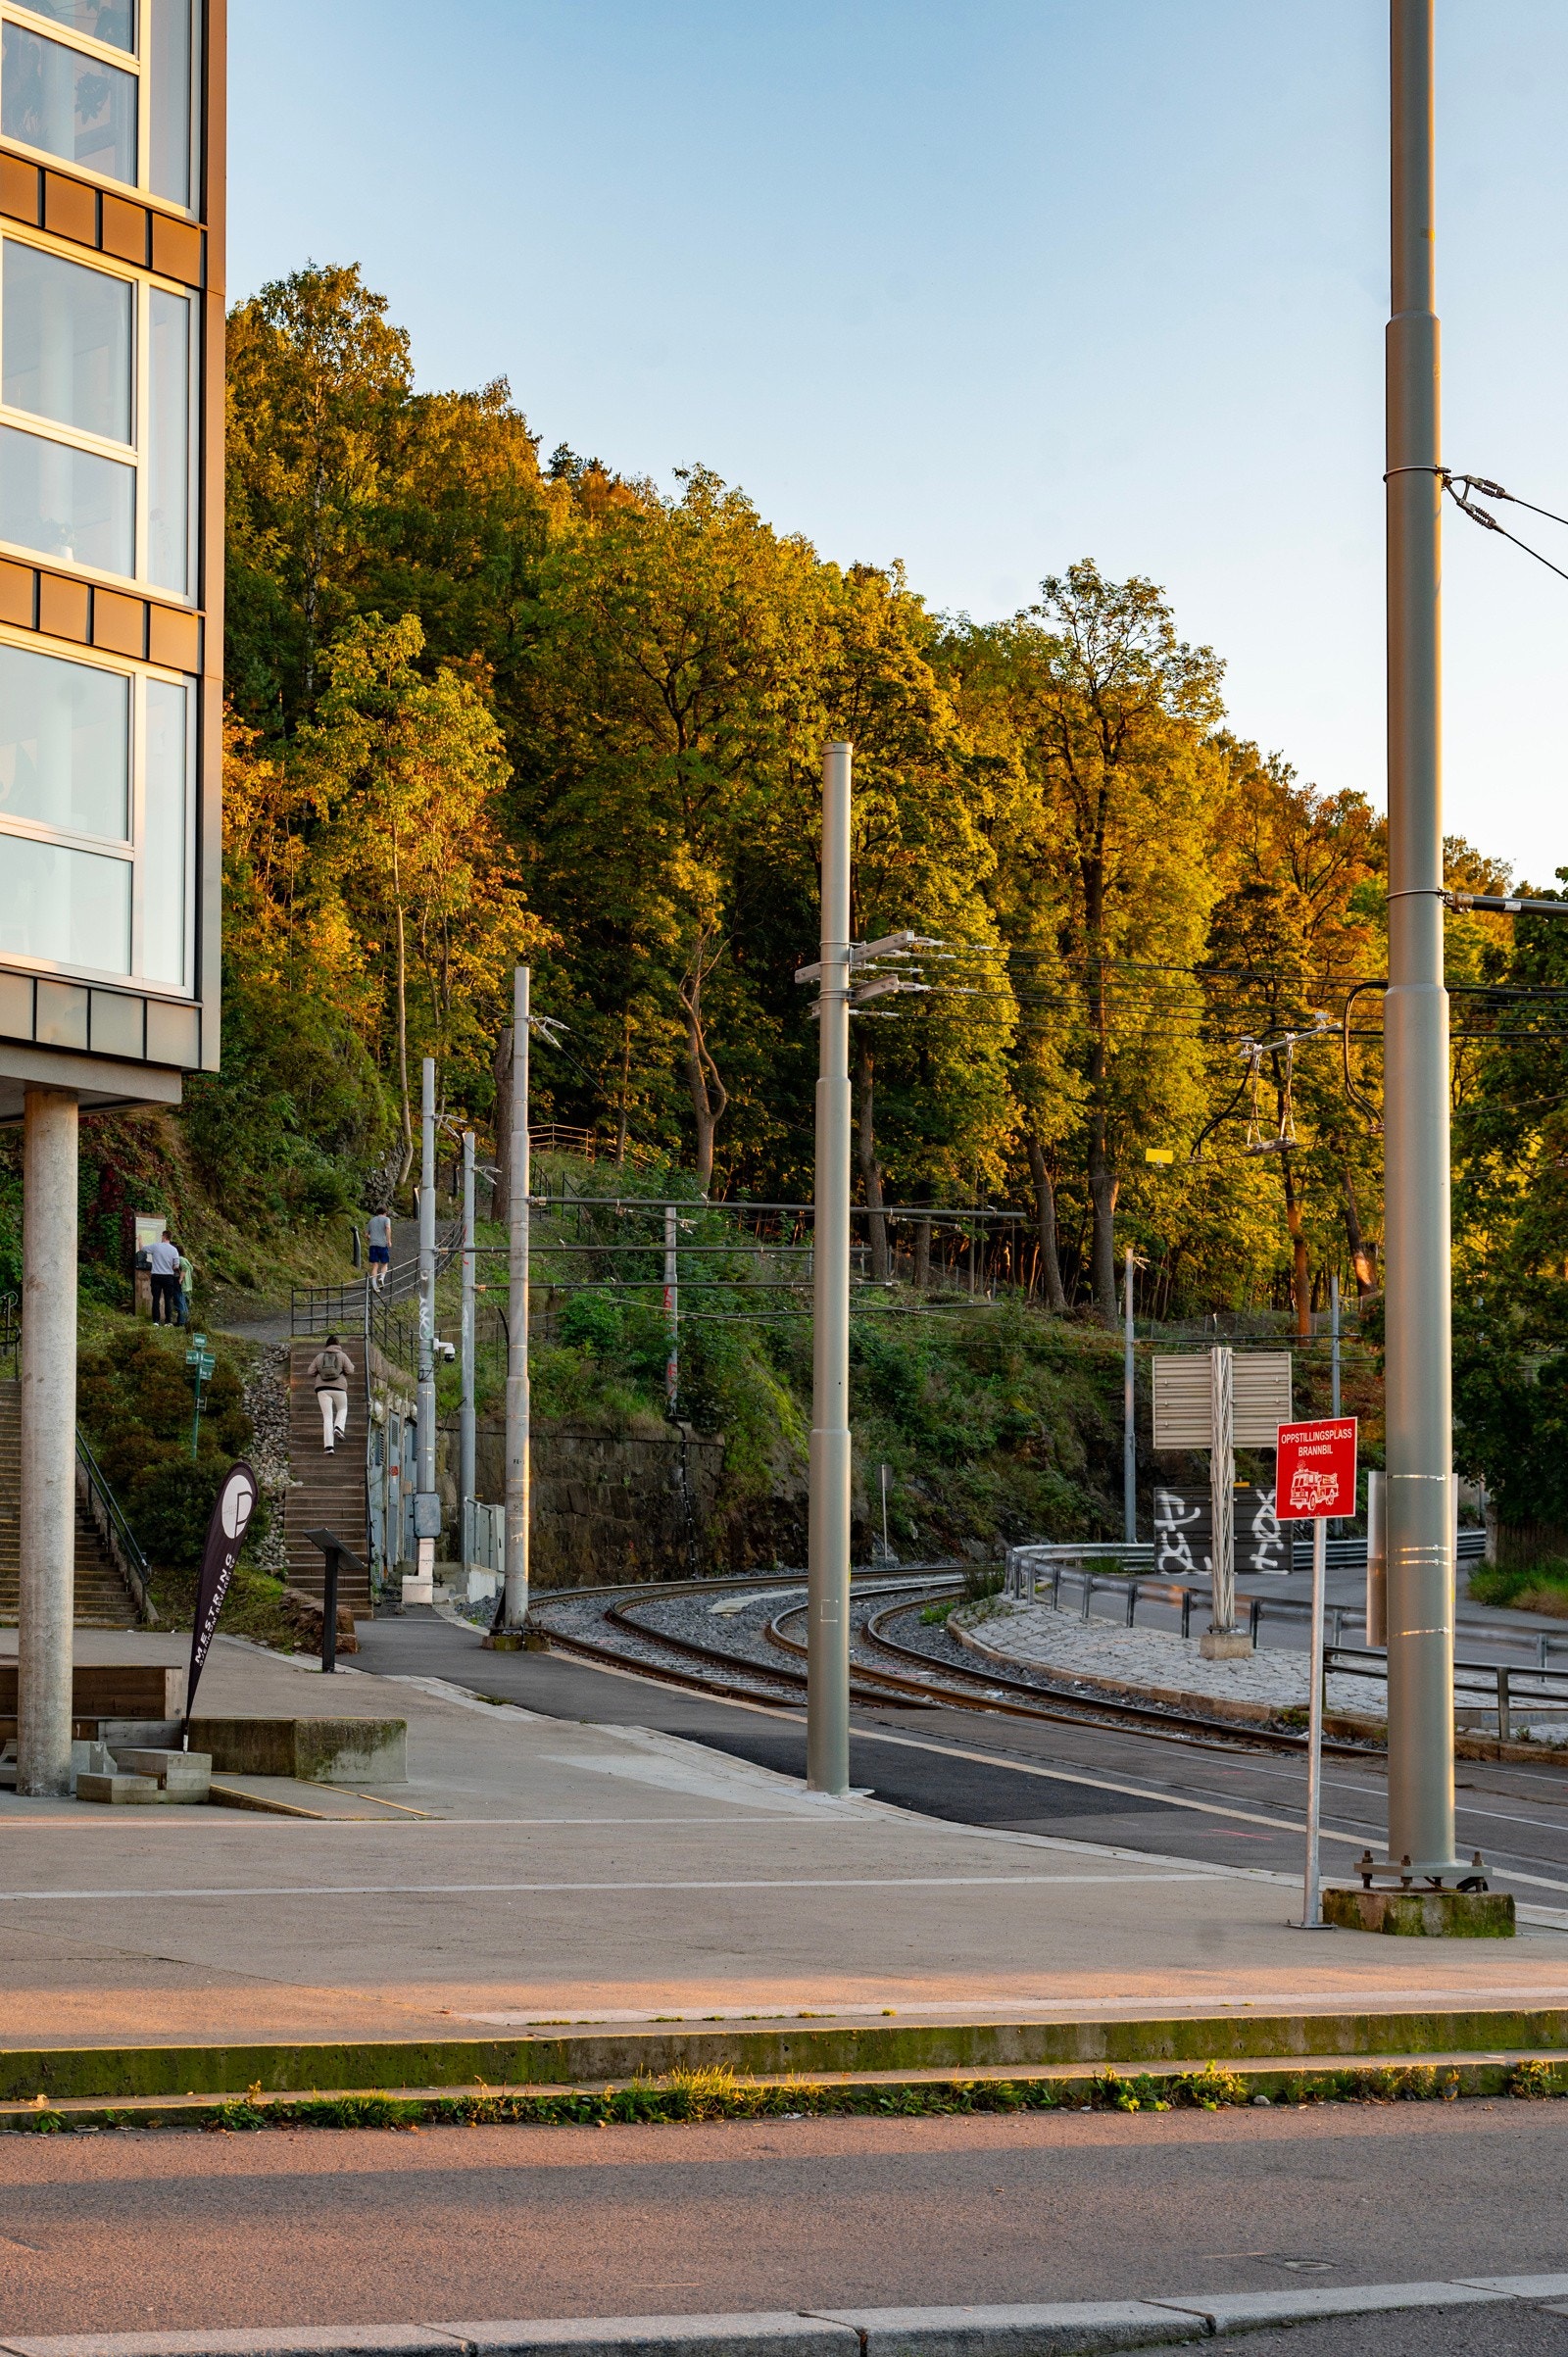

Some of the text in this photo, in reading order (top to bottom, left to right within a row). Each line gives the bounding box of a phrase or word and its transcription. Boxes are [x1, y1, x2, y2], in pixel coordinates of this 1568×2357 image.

[1281, 1428, 1352, 1444] OPPSTILLINGSPLASS
[1298, 1445, 1333, 1456] BRANNBIL
[195, 1553, 232, 1664] MESTRING
